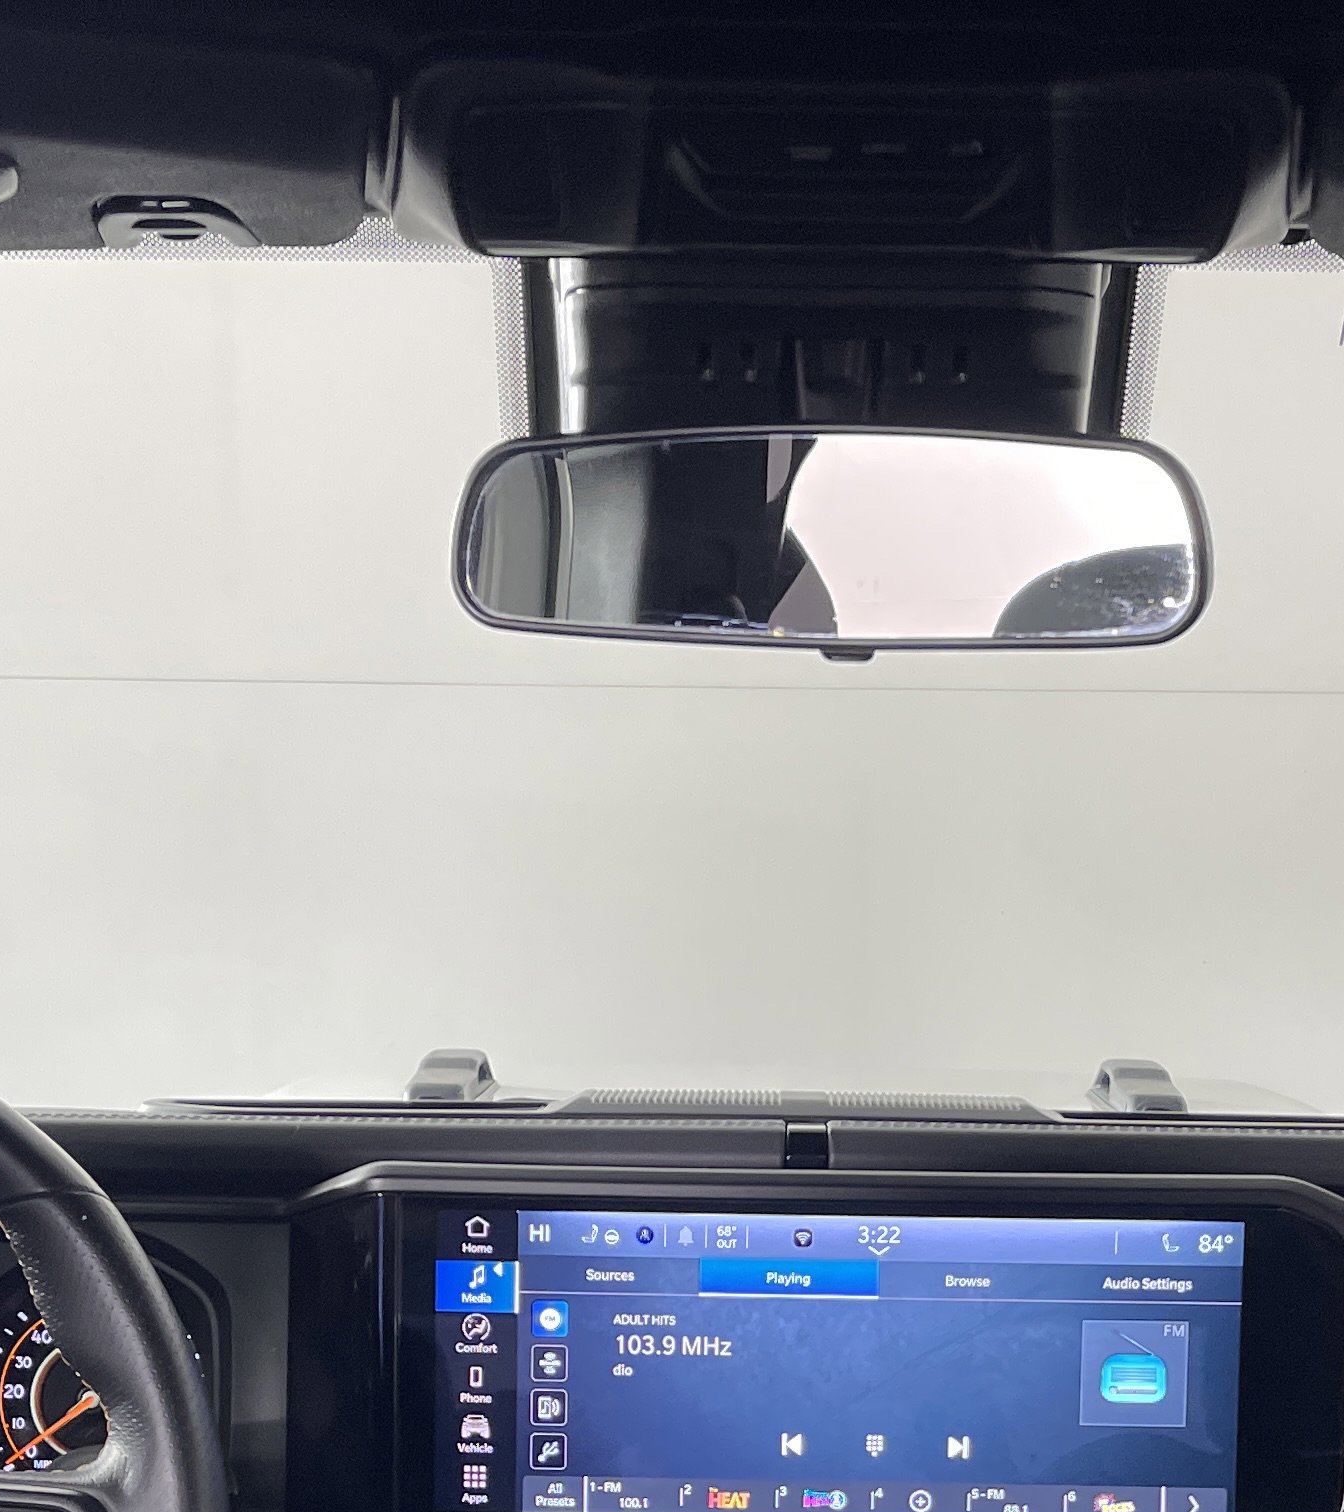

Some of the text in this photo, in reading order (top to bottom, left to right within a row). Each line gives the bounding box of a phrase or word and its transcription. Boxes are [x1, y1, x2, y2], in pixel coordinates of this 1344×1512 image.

[529, 1224, 551, 1243] HI
[716, 1225, 738, 1238] 68°
[857, 1225, 901, 1245] 3:22
[461, 1243, 493, 1255] Home
[716, 1239, 738, 1250] OUT
[1198, 1234, 1233, 1253] 84°
[585, 1269, 635, 1282] Sources
[765, 1271, 811, 1287] Playing
[944, 1274, 991, 1287] Browse
[1102, 1277, 1193, 1293] Audio Settings
[461, 1293, 492, 1305] Media
[613, 1314, 677, 1326] ADULT HITS
[31, 1330, 52, 1345] 40
[1163, 1325, 1185, 1338] FM
[455, 1342, 497, 1354] Comfort
[615, 1335, 733, 1357] 103.9 MHz
[14, 1355, 32, 1370] 30
[612, 1364, 633, 1377] dio
[4, 1384, 25, 1399] 20
[459, 1392, 492, 1404] Phone
[11, 1417, 25, 1430] 10
[25, 1445, 36, 1460] 0
[457, 1442, 493, 1455] Vehicle
[547, 1483, 563, 1494] All
[461, 1493, 488, 1506] Apps
[535, 1495, 575, 1508] Presets
[619, 1497, 649, 1509] 100.1
[708, 1491, 750, 1510] HEAT
